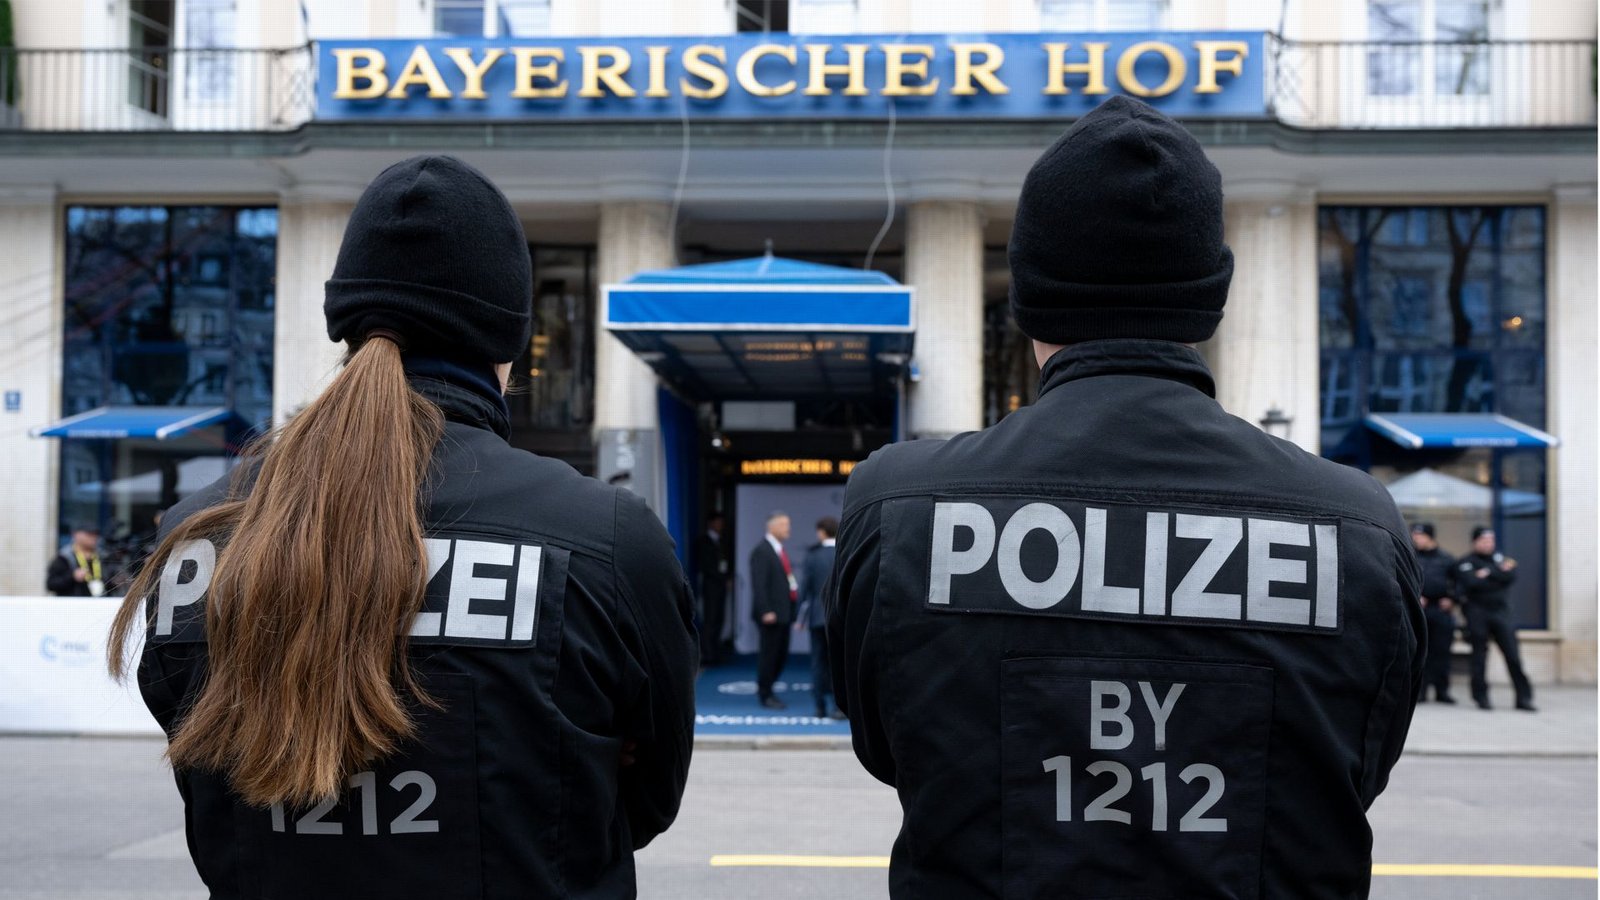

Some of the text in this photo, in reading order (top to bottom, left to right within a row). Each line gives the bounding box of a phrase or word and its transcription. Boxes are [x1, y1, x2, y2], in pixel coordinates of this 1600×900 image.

[333, 41, 1249, 99] BAYERISCHER HOF
[155, 538, 542, 641] PZEI
[929, 502, 1338, 628] POLIZEI
[1090, 680, 1187, 751] BY
[1042, 755, 1228, 832] 1212
